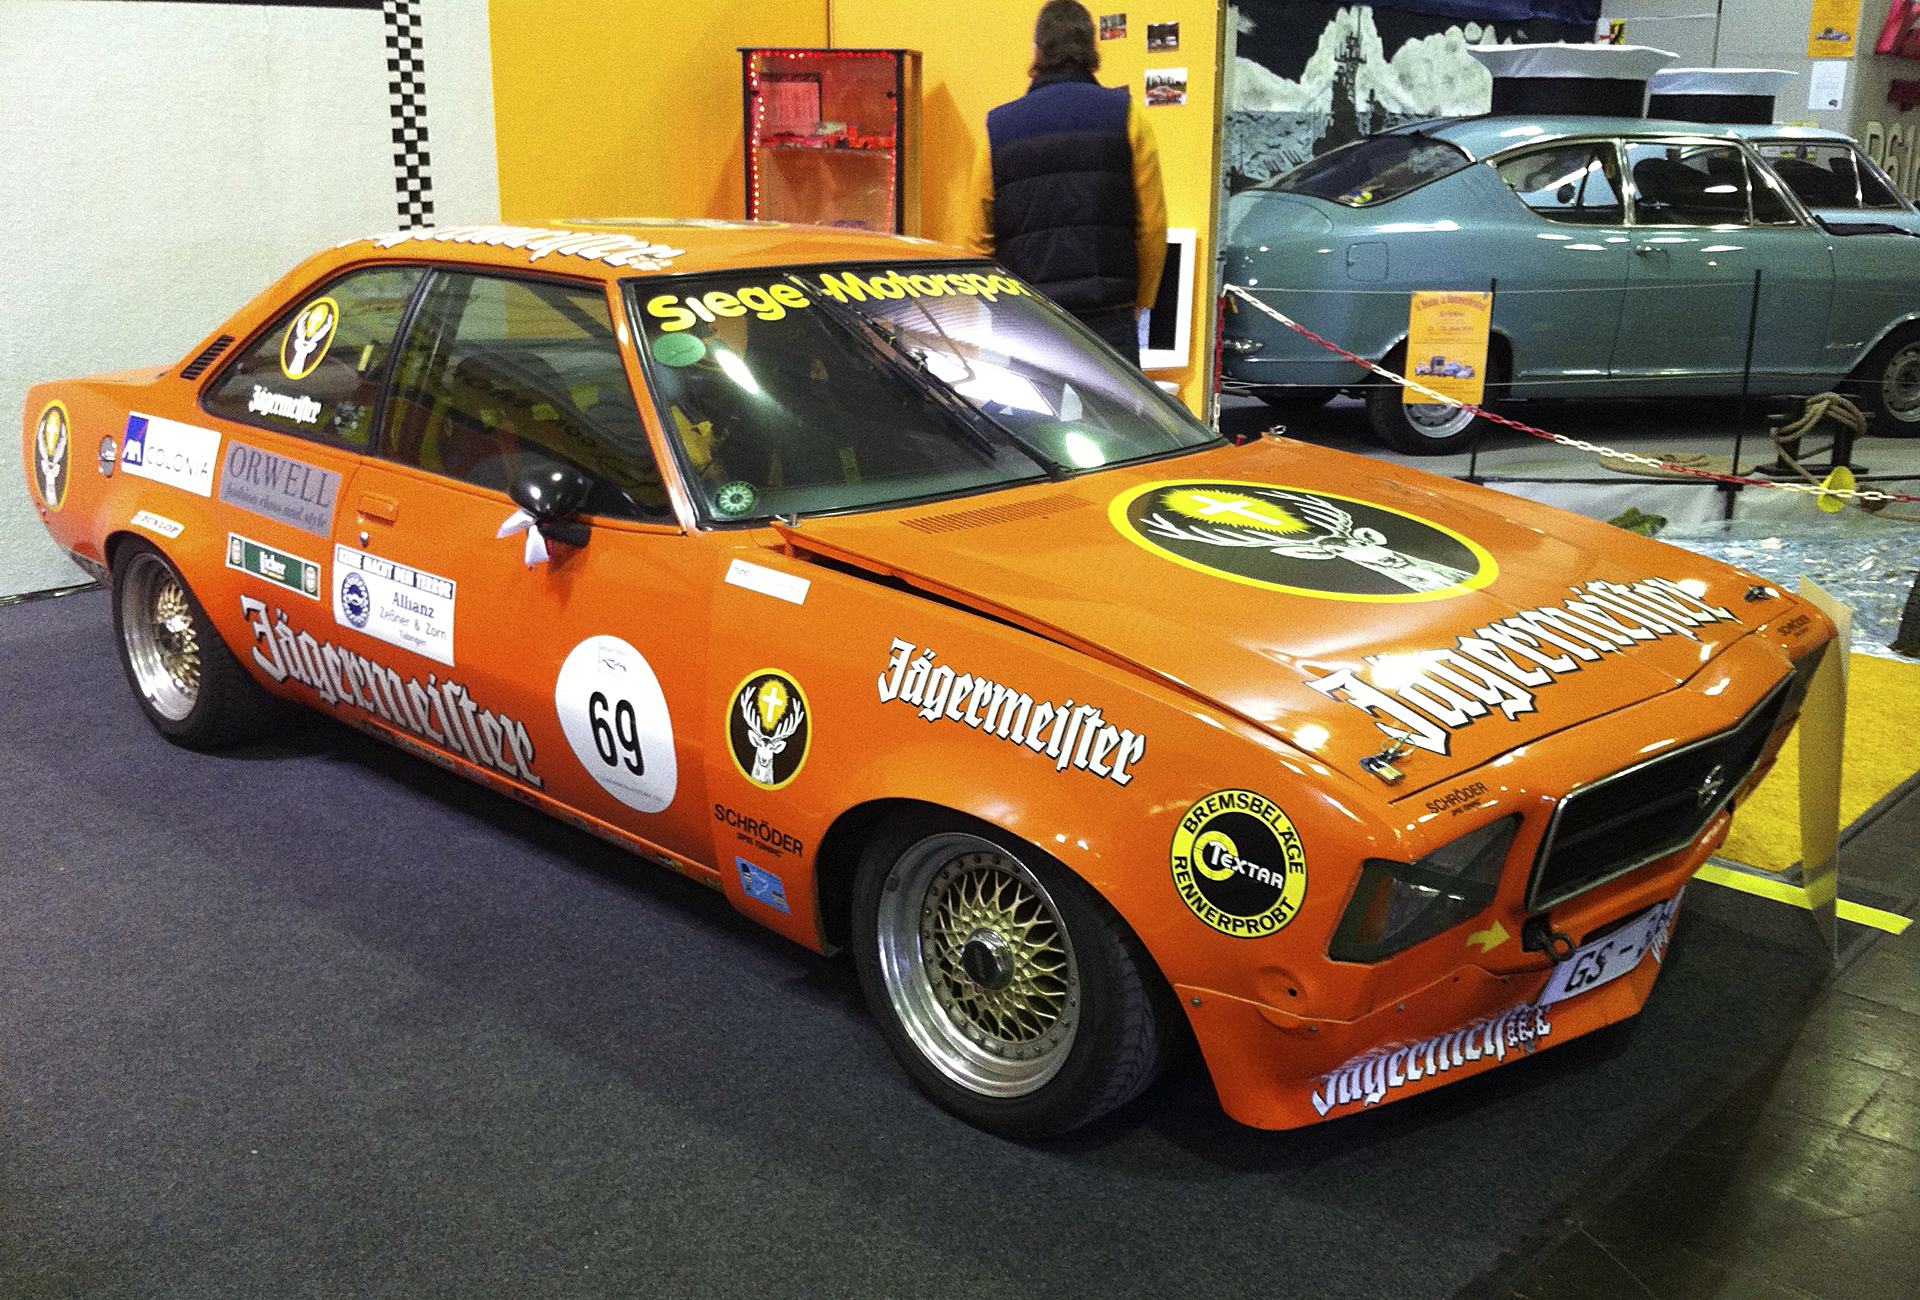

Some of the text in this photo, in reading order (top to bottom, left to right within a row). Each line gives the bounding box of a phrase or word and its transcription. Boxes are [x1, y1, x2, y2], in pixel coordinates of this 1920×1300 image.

[146, 445, 209, 480] COLONIA
[228, 446, 331, 509] ORWELL
[392, 591, 435, 619] Allianz
[413, 618, 421, 632] &
[426, 622, 448, 641] Zorn
[588, 690, 645, 777] 69
[1425, 781, 1490, 814] SCHRÖDER
[714, 803, 804, 859] SCHRÖDER
[1182, 792, 1304, 876] BREMSBELÄGE
[1173, 855, 1296, 935] RENNERPROBT
